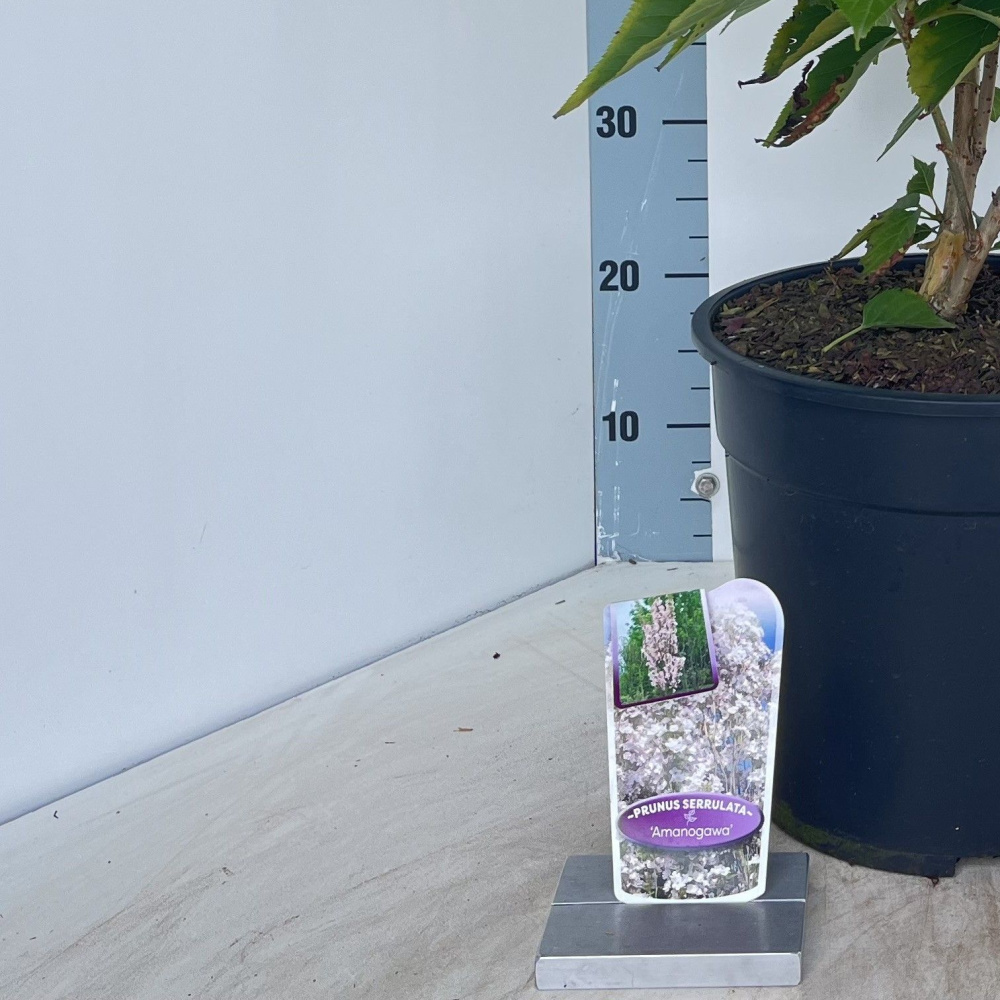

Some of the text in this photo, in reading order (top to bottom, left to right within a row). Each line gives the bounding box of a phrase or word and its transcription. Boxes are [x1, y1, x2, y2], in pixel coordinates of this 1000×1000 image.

[596, 105, 637, 138] 30
[599, 259, 640, 291] 20
[602, 410, 639, 442] 10
